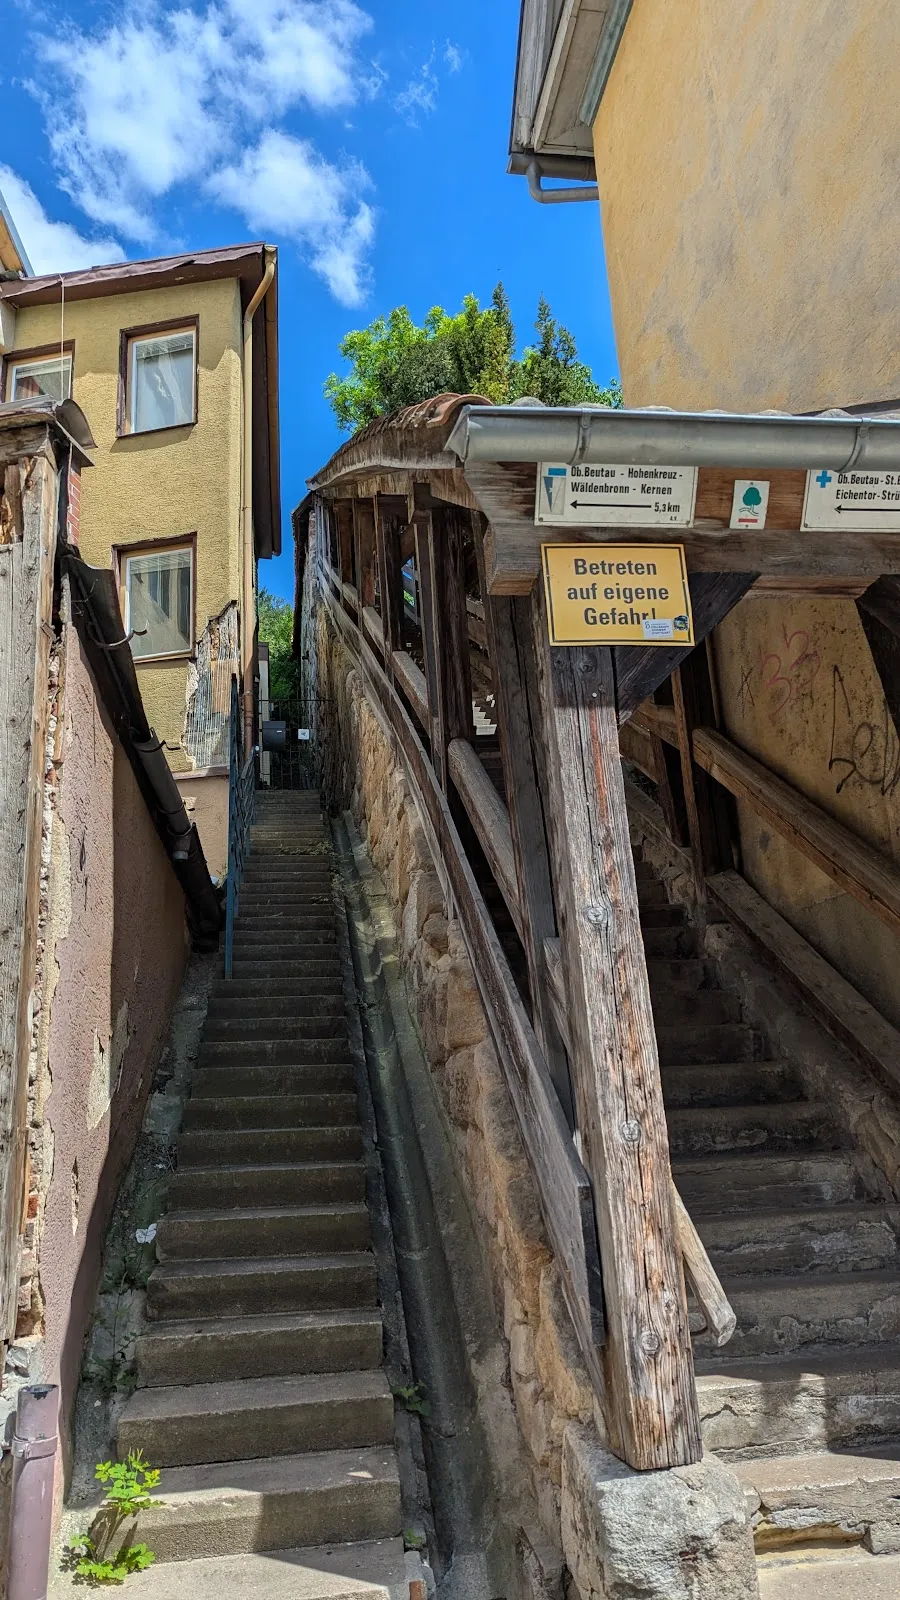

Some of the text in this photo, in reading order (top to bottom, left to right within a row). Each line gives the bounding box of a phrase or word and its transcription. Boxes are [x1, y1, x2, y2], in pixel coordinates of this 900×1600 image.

[628, 468, 678, 479] Hohenkreuz
[571, 482, 630, 494] Wäldenbronn
[640, 484, 672, 495] Kernen
[573, 558, 657, 576] Betreten
[567, 583, 669, 604] auf eigene
[584, 607, 656, 626] Gefahr!
